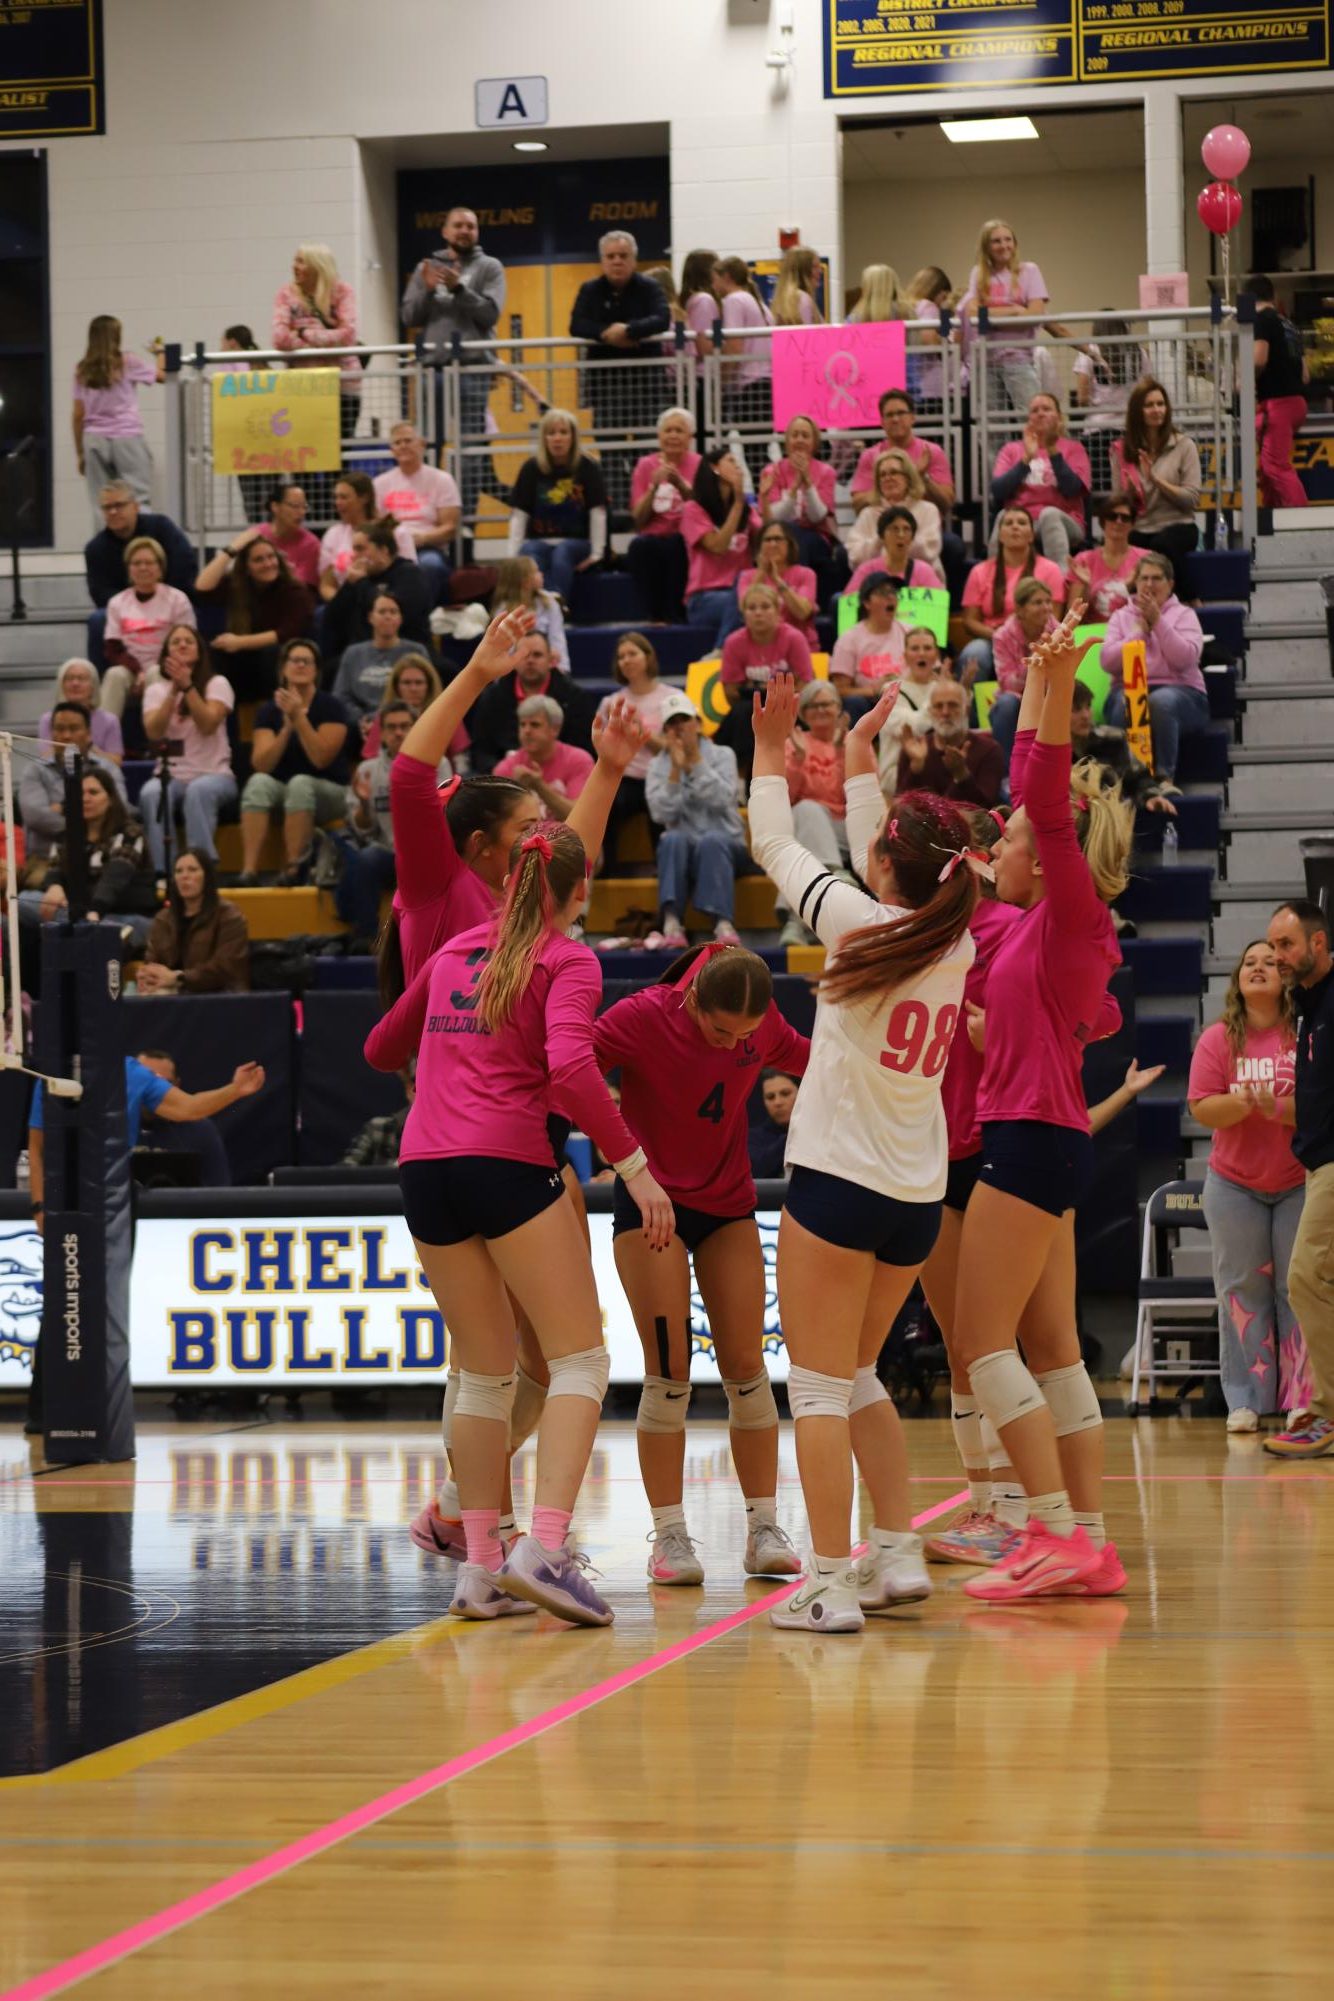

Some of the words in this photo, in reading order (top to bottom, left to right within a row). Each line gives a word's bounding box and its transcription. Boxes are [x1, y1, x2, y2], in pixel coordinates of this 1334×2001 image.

[852, 45, 944, 63] REGIONAL
[949, 37, 1059, 58] CHAMPIONS
[1100, 29, 1192, 48] REGIONAL
[1198, 21, 1310, 42] CHAMPIONS
[497, 83, 528, 119] A
[415, 206, 536, 228] WRTLING
[589, 201, 660, 221] ROOM
[219, 372, 277, 398] ALLY
[880, 1000, 958, 1078] 98
[1236, 1057, 1275, 1081] DIG
[698, 1081, 725, 1124] 4
[62, 1233, 82, 1290] sports
[63, 1291, 82, 1361] imports
